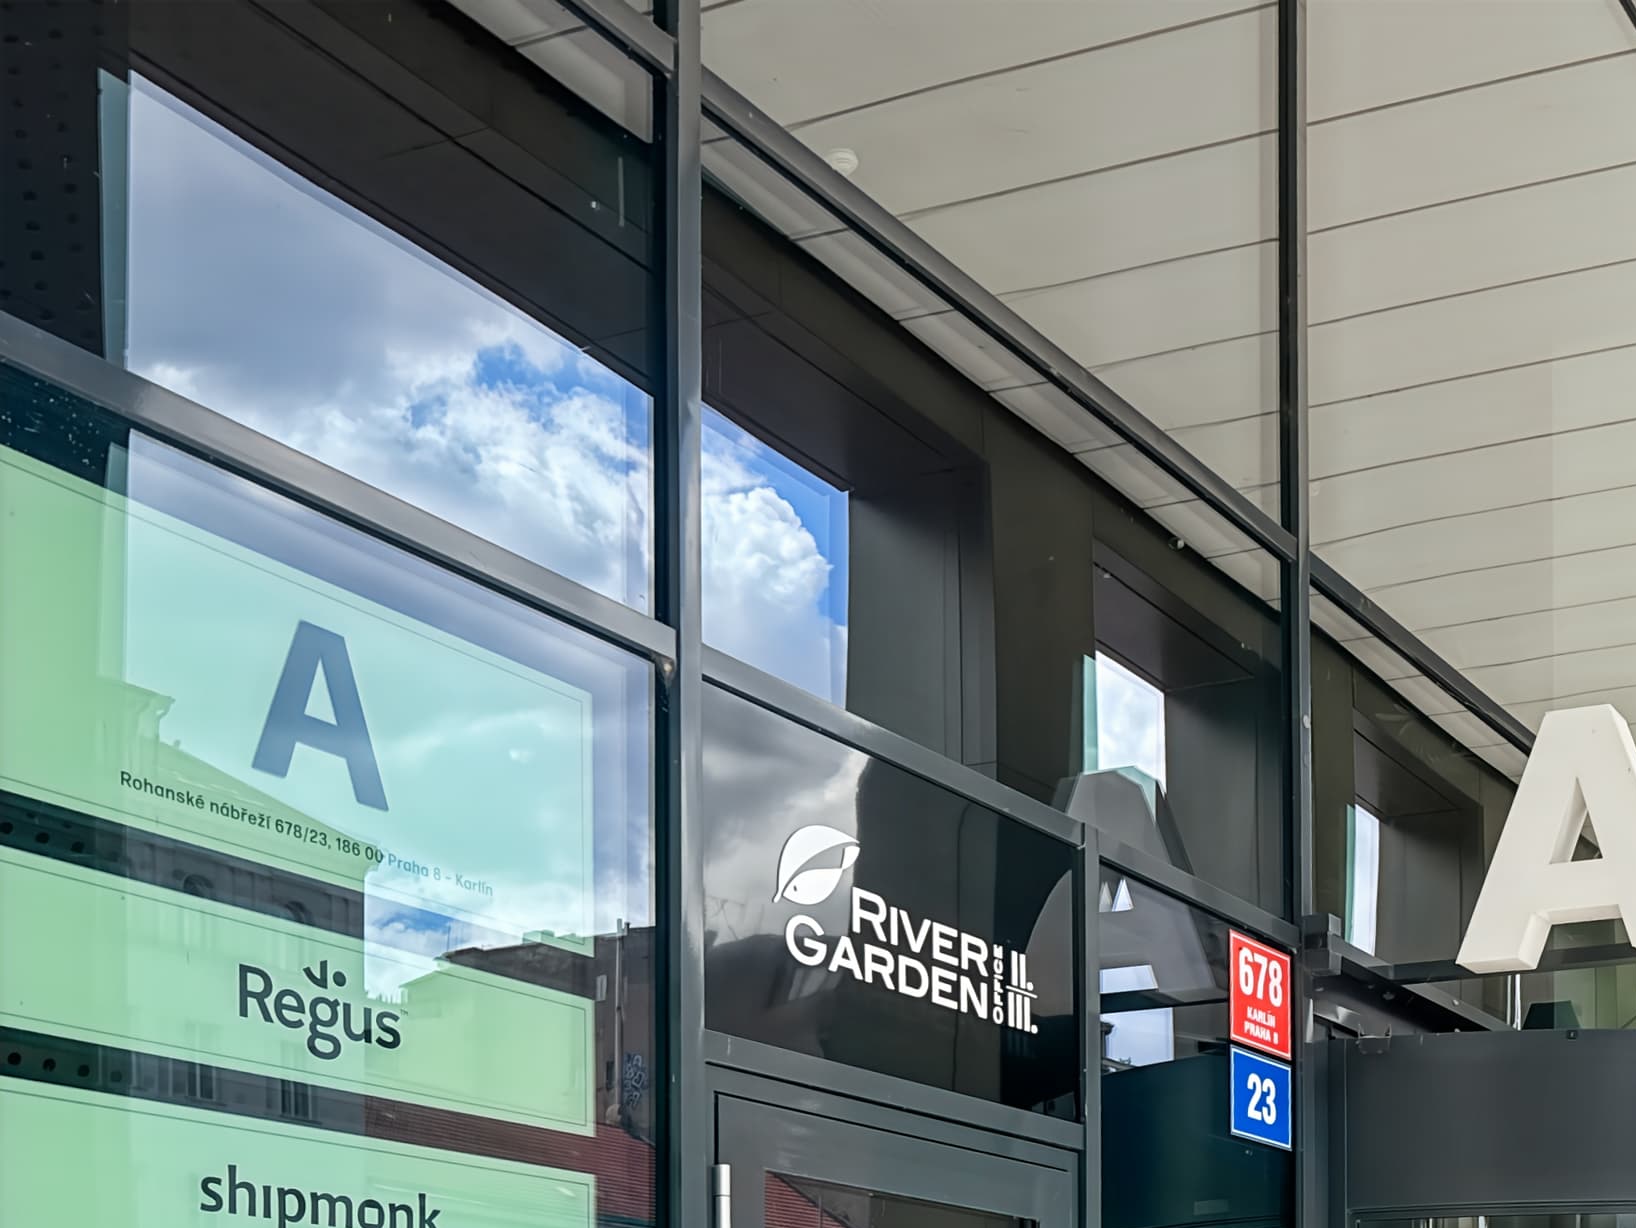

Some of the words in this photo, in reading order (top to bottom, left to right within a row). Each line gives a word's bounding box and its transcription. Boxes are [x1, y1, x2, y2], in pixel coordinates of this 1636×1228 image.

[251, 618, 390, 813] A
[119, 769, 206, 811] Rohanské
[209, 799, 272, 830] nábřeží
[274, 818, 332, 850] 678/23,
[335, 836, 361, 857] 186
[364, 845, 384, 864] 00
[387, 852, 430, 878] Praha
[433, 866, 442, 882] 8
[454, 871, 494, 897] Karlín
[784, 913, 989, 1021] GARDEN
[851, 885, 990, 978] RIVER
[1238, 946, 1283, 1008] 678
[1243, 1020, 1272, 1042] PRAHA
[1246, 1072, 1277, 1126] 23
